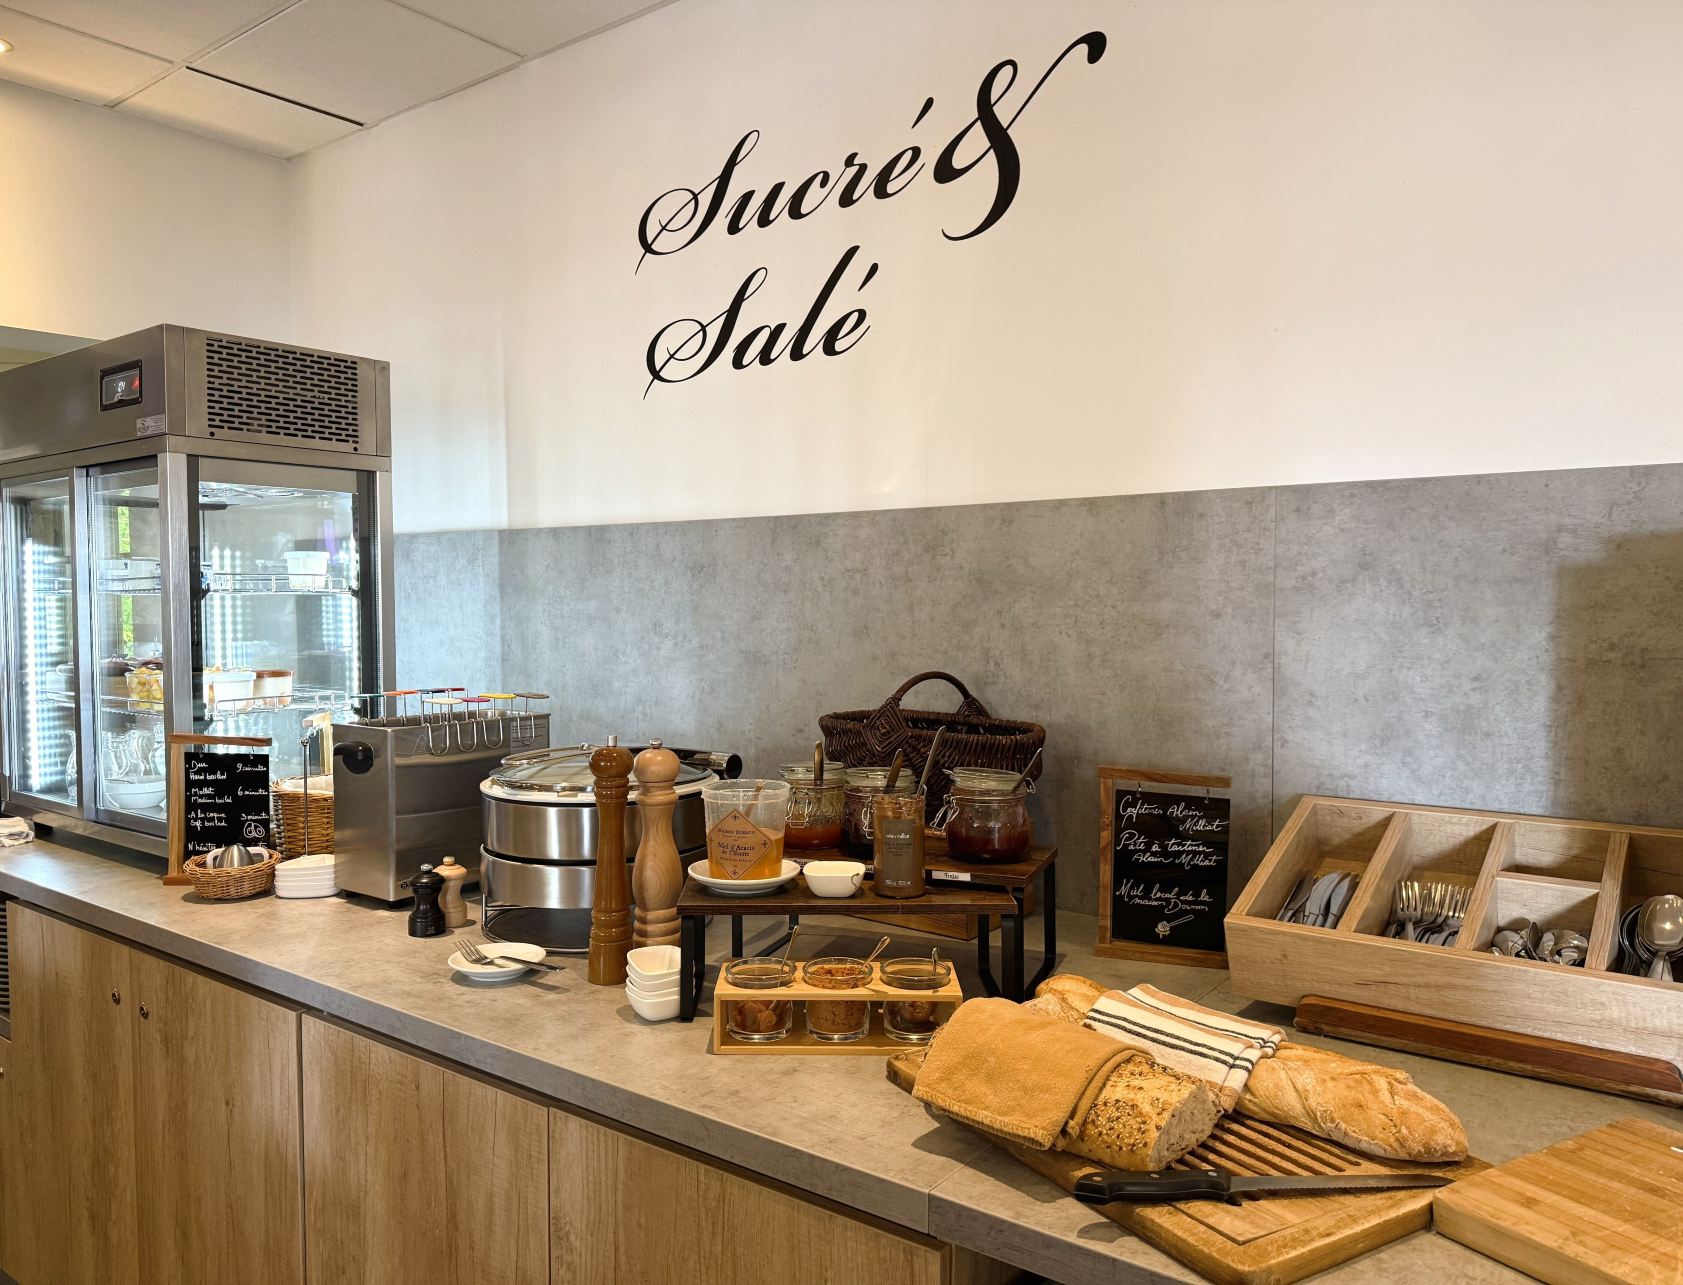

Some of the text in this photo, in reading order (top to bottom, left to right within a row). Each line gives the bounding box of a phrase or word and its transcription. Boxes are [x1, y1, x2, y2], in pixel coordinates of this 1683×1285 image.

[635, 31, 1107, 275] Sucré &
[643, 245, 879, 400] Salé
[189, 770, 227, 781] Hard boiled
[191, 786, 215, 796] Mollet
[237, 786, 243, 796] 6
[215, 795, 233, 804] boiled
[197, 809, 205, 818] la
[206, 812, 227, 823] coque
[1120, 795, 1203, 828] Confitures Alain
[190, 819, 228, 831] Soft boiled
[1179, 817, 1229, 834] Milliat
[1116, 830, 1214, 853] Pâte à tartiner
[1132, 852, 1223, 870] Alain Milliat
[1116, 878, 1214, 902] Miel local de la
[1130, 897, 1166, 906] maison
